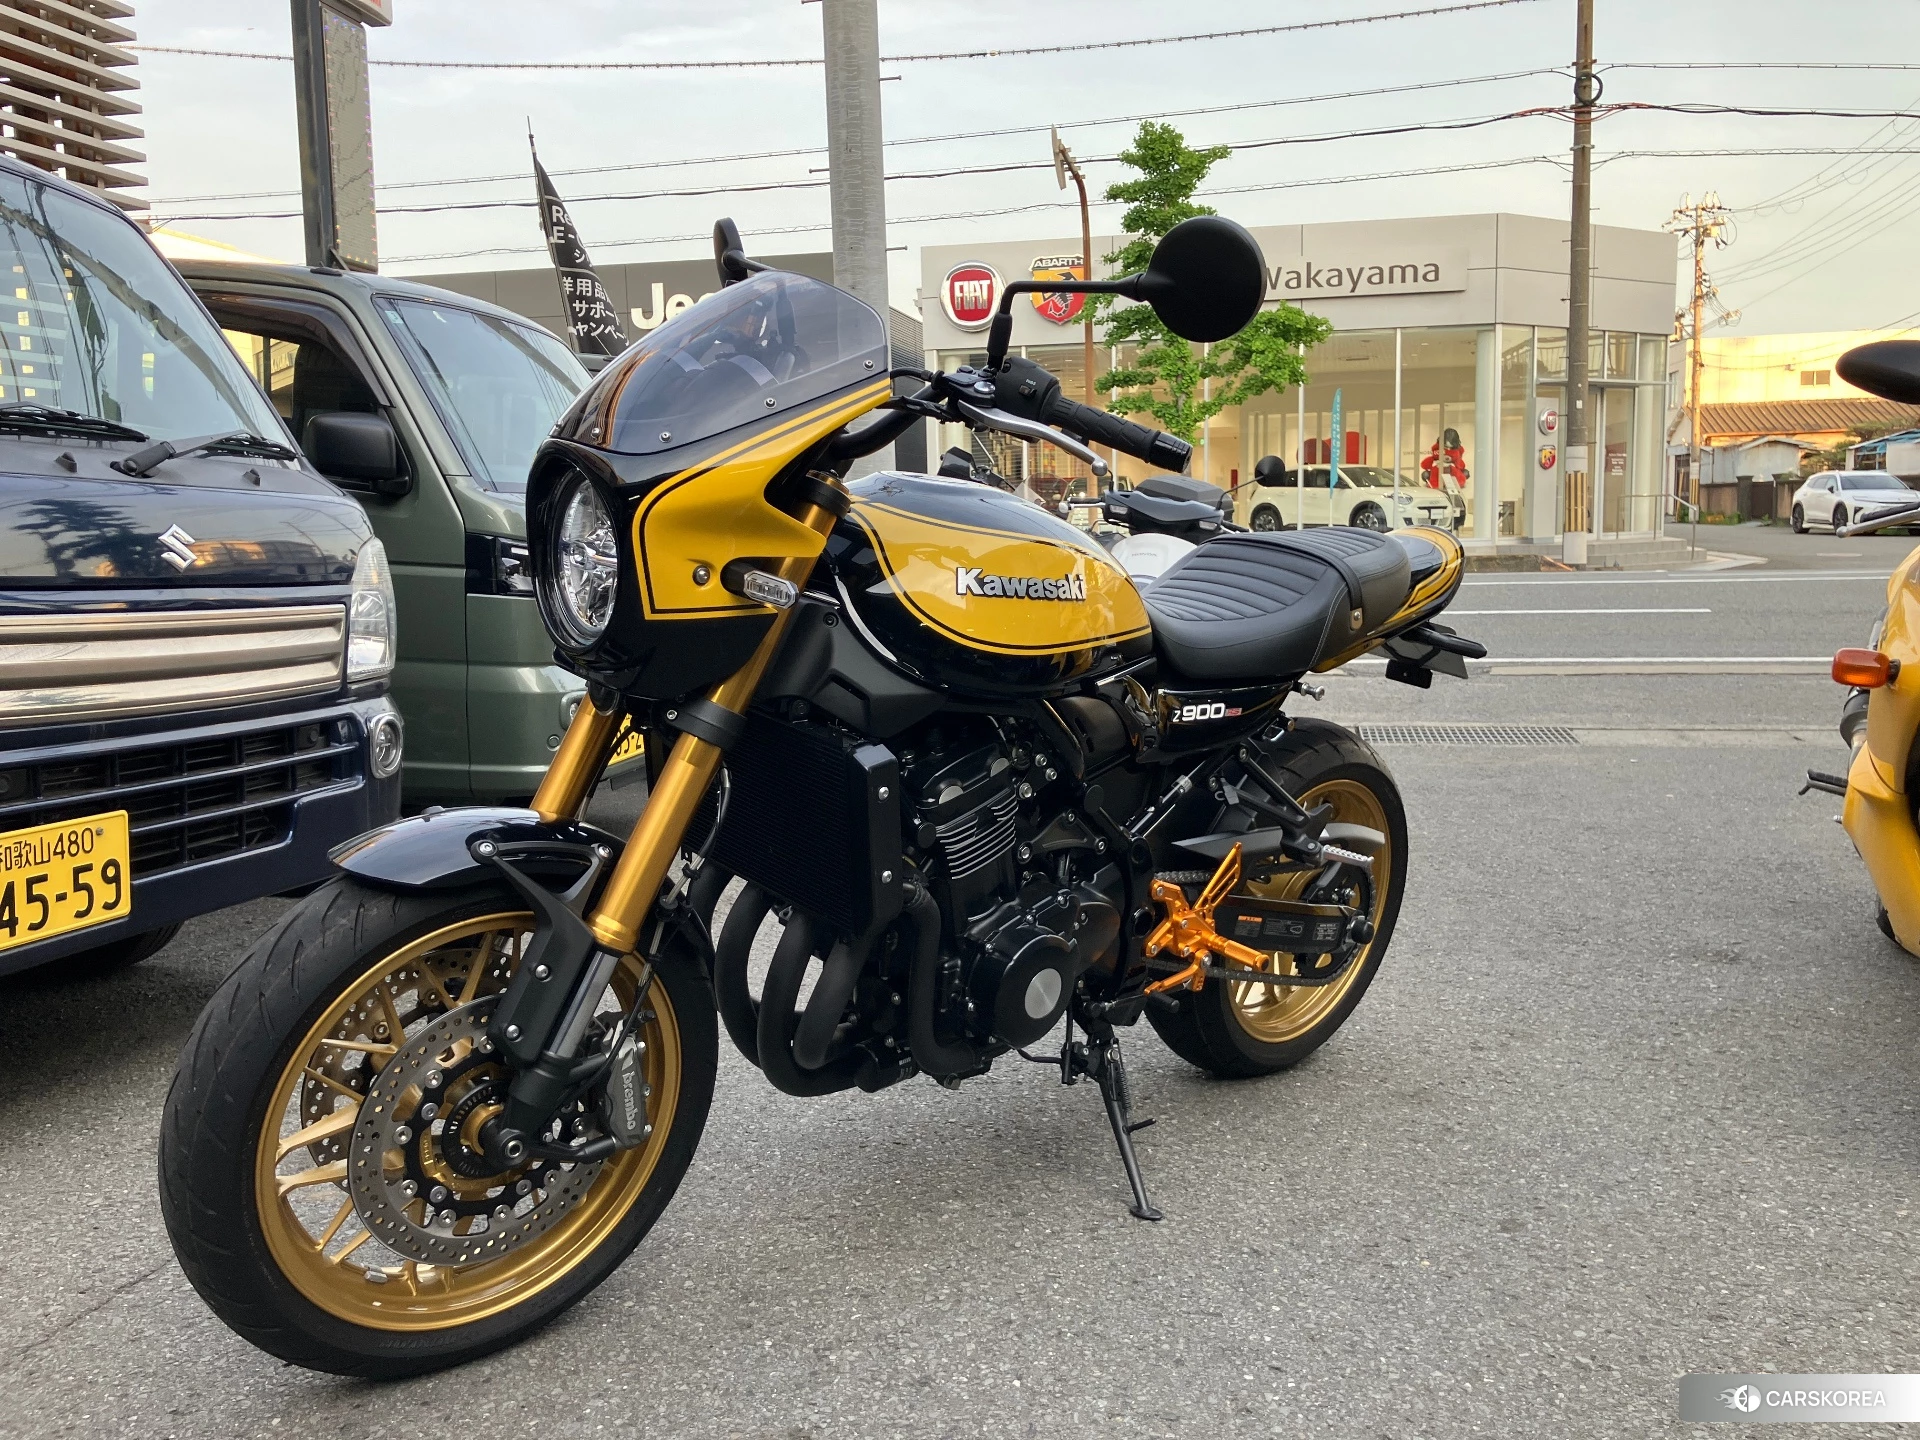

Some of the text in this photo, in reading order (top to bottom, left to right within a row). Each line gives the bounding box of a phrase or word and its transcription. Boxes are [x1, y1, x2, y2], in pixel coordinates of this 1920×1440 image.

[1033, 258, 1084, 268] ABARTH
[631, 282, 716, 330] Je
[954, 279, 991, 311] FIAT
[956, 567, 1086, 601] Kawasaki
[0, 858, 122, 938] 45-59
[622, 1070, 639, 1130] brembo
